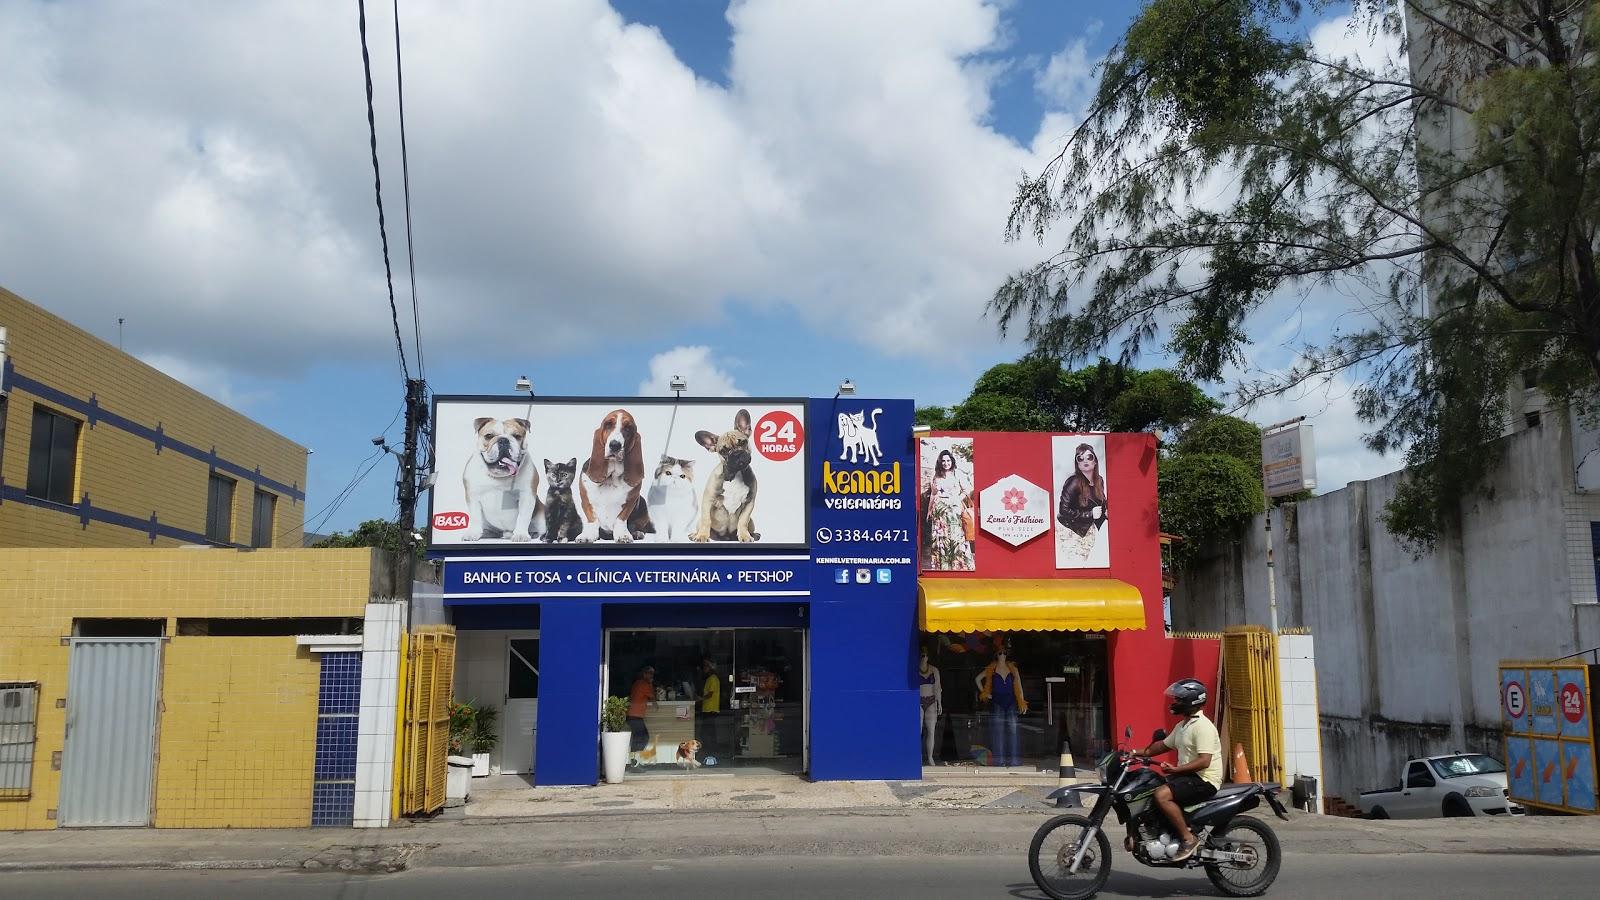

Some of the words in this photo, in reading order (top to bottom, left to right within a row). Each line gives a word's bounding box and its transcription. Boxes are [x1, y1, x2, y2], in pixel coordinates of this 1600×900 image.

[760, 420, 797, 443] 24
[761, 444, 796, 453] HORAS
[823, 461, 901, 494] kennel
[824, 495, 902, 510] veterinária
[434, 515, 467, 527] IBASA
[986, 514, 1012, 524] Lena's
[1012, 514, 1045, 525] Fashion
[835, 529, 909, 542] 3384.6471
[816, 557, 911, 565] KENNELVETERINARIA.COM.BR
[463, 571, 511, 584] BANHO
[514, 571, 523, 584] E
[525, 571, 562, 584] TOSA
[577, 567, 633, 584] CLÍNICA
[635, 567, 721, 583] VETERINÁRIA
[738, 570, 794, 583] PETSHOP
[1510, 691, 1519, 708] E
[1563, 690, 1580, 708] 24
